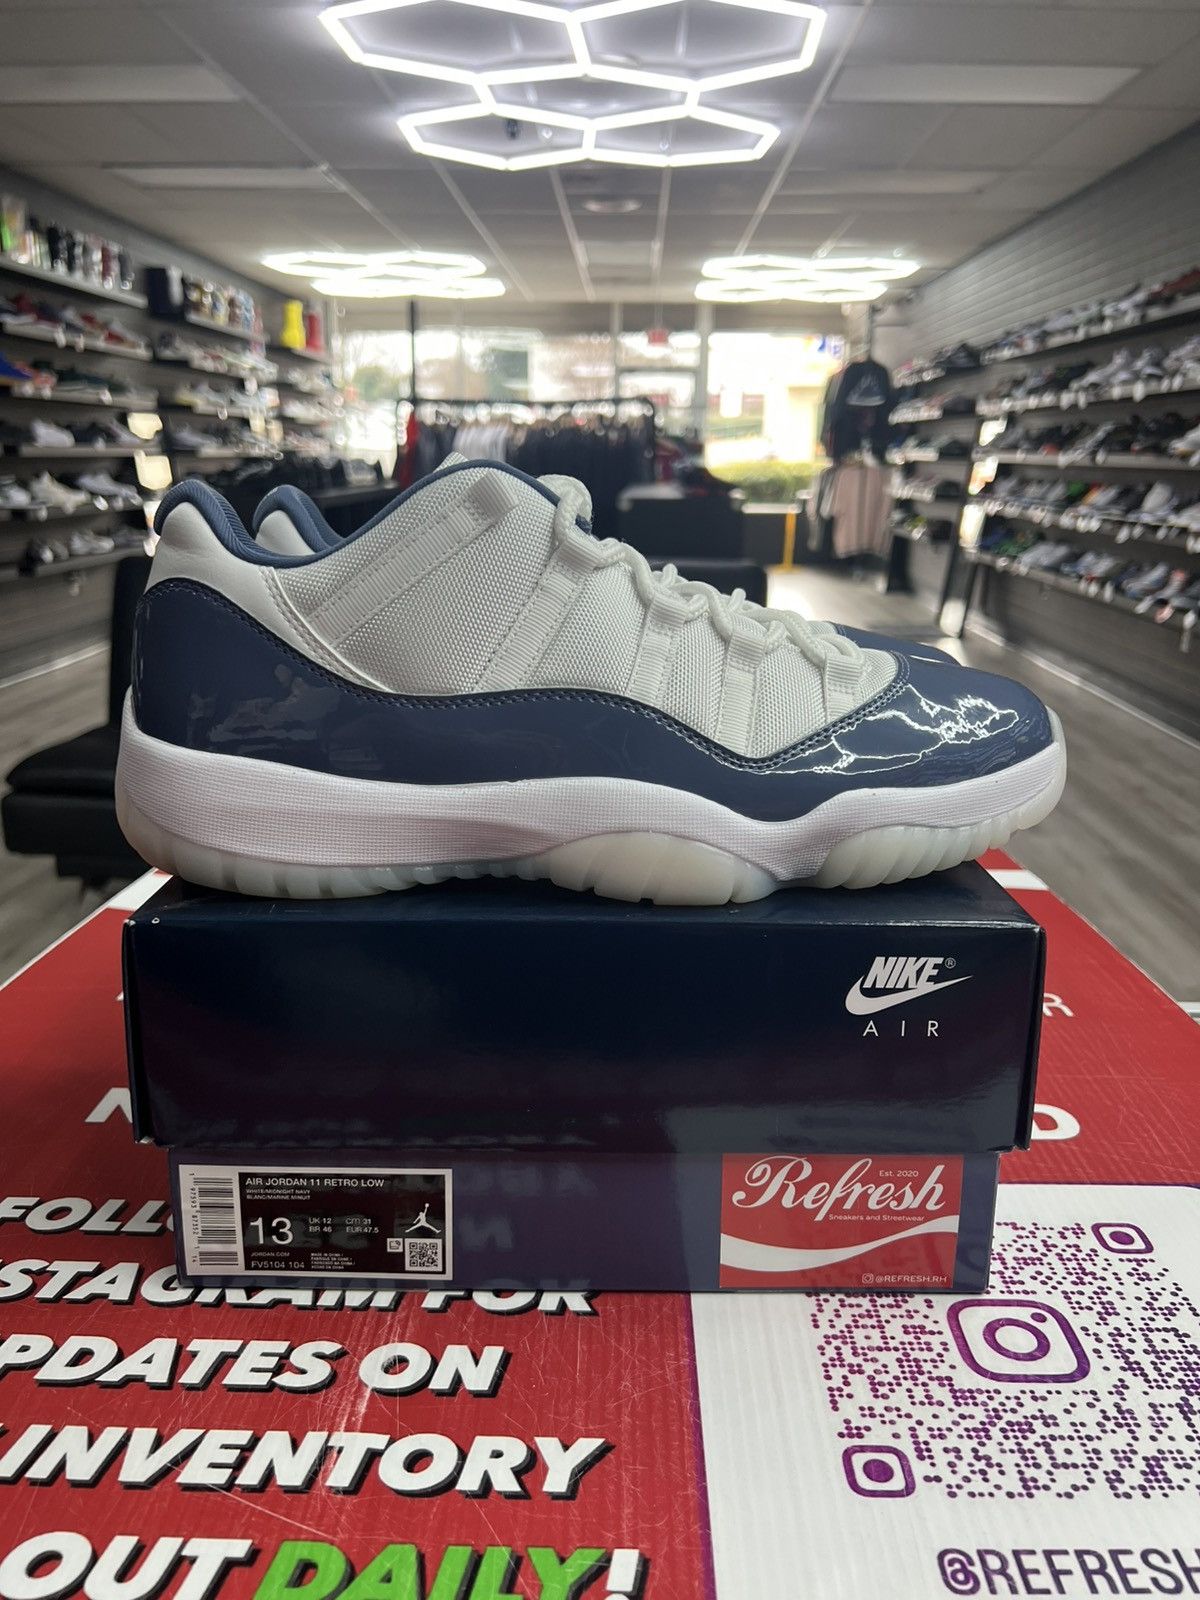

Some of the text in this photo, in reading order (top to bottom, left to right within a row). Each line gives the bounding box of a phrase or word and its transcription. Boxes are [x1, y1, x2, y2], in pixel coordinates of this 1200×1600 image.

[862, 956, 944, 989] NIKE
[862, 1020, 939, 1037] AIR
[245, 1178, 385, 1187] AIR JORDAN 11 RETRO LOW
[732, 1155, 946, 1221] Refresh
[0, 1197, 174, 1232] FOLL
[250, 1216, 294, 1245] 13
[882, 1214, 925, 1222] Streetwear
[0, 1259, 397, 1307] STAG
[875, 1275, 947, 1284] @REFRESH.RH
[0, 1334, 504, 1392] PDATES ON
[0, 1424, 605, 1494] INVENTORY
[0, 1531, 253, 1600] OUT
